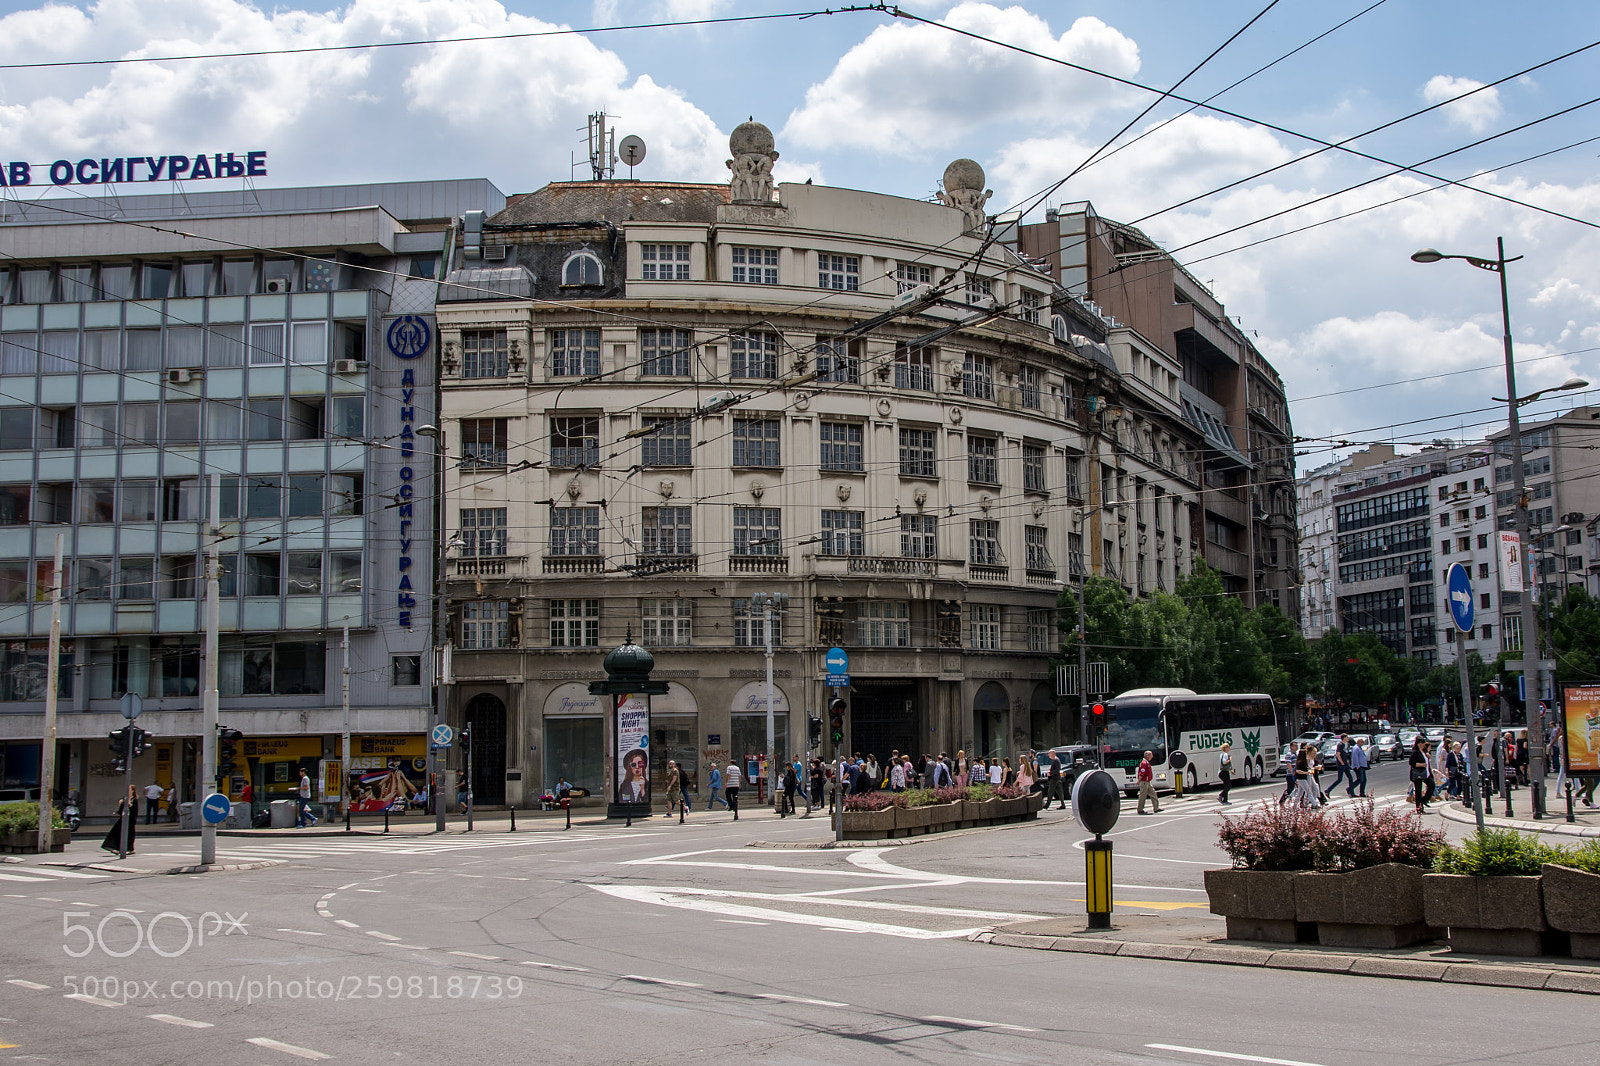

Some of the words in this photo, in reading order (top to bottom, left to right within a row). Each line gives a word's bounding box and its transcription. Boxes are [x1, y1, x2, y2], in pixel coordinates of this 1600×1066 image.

[50, 151, 267, 185] ОСИГУРАЊЕ
[401, 369, 415, 458] ДУНАВ
[398, 466, 416, 626] ОСИГУРАЊЕ
[621, 719, 641, 728] NIGHT
[374, 738, 406, 746] PIRAEUS
[1190, 732, 1233, 751] FUDEKS
